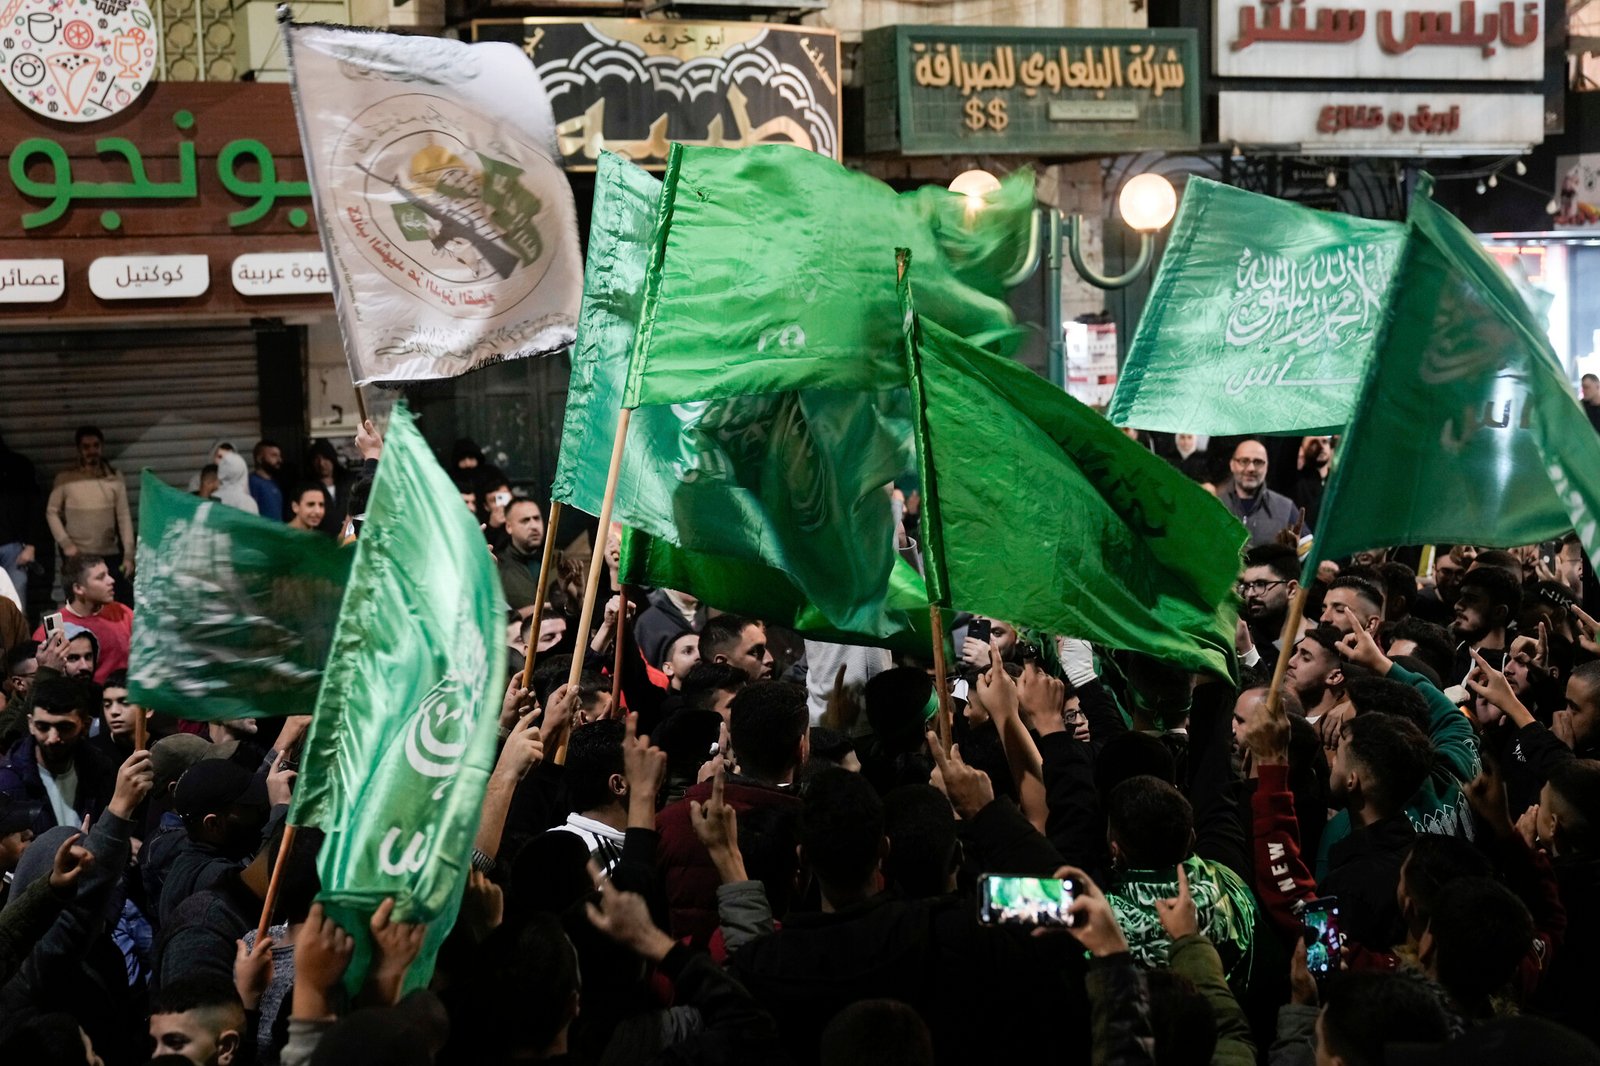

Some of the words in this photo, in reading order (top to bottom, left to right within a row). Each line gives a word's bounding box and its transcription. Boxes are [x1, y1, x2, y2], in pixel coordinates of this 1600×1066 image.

[1229, 0, 1366, 52] سنتر
[1376, 0, 1539, 58] نابلس
[913, 43, 1016, 95] للصرافة
[1020, 46, 1124, 98] البلعاوي
[1127, 44, 1185, 97] شركة
[0, 267, 60, 291] عصائر
[115, 264, 184, 288] كوكتيل
[238, 264, 285, 285] عربية
[291, 262, 331, 284] هوة
[1540, 587, 1574, 610] NIK
[1267, 842, 1297, 892] NEW
